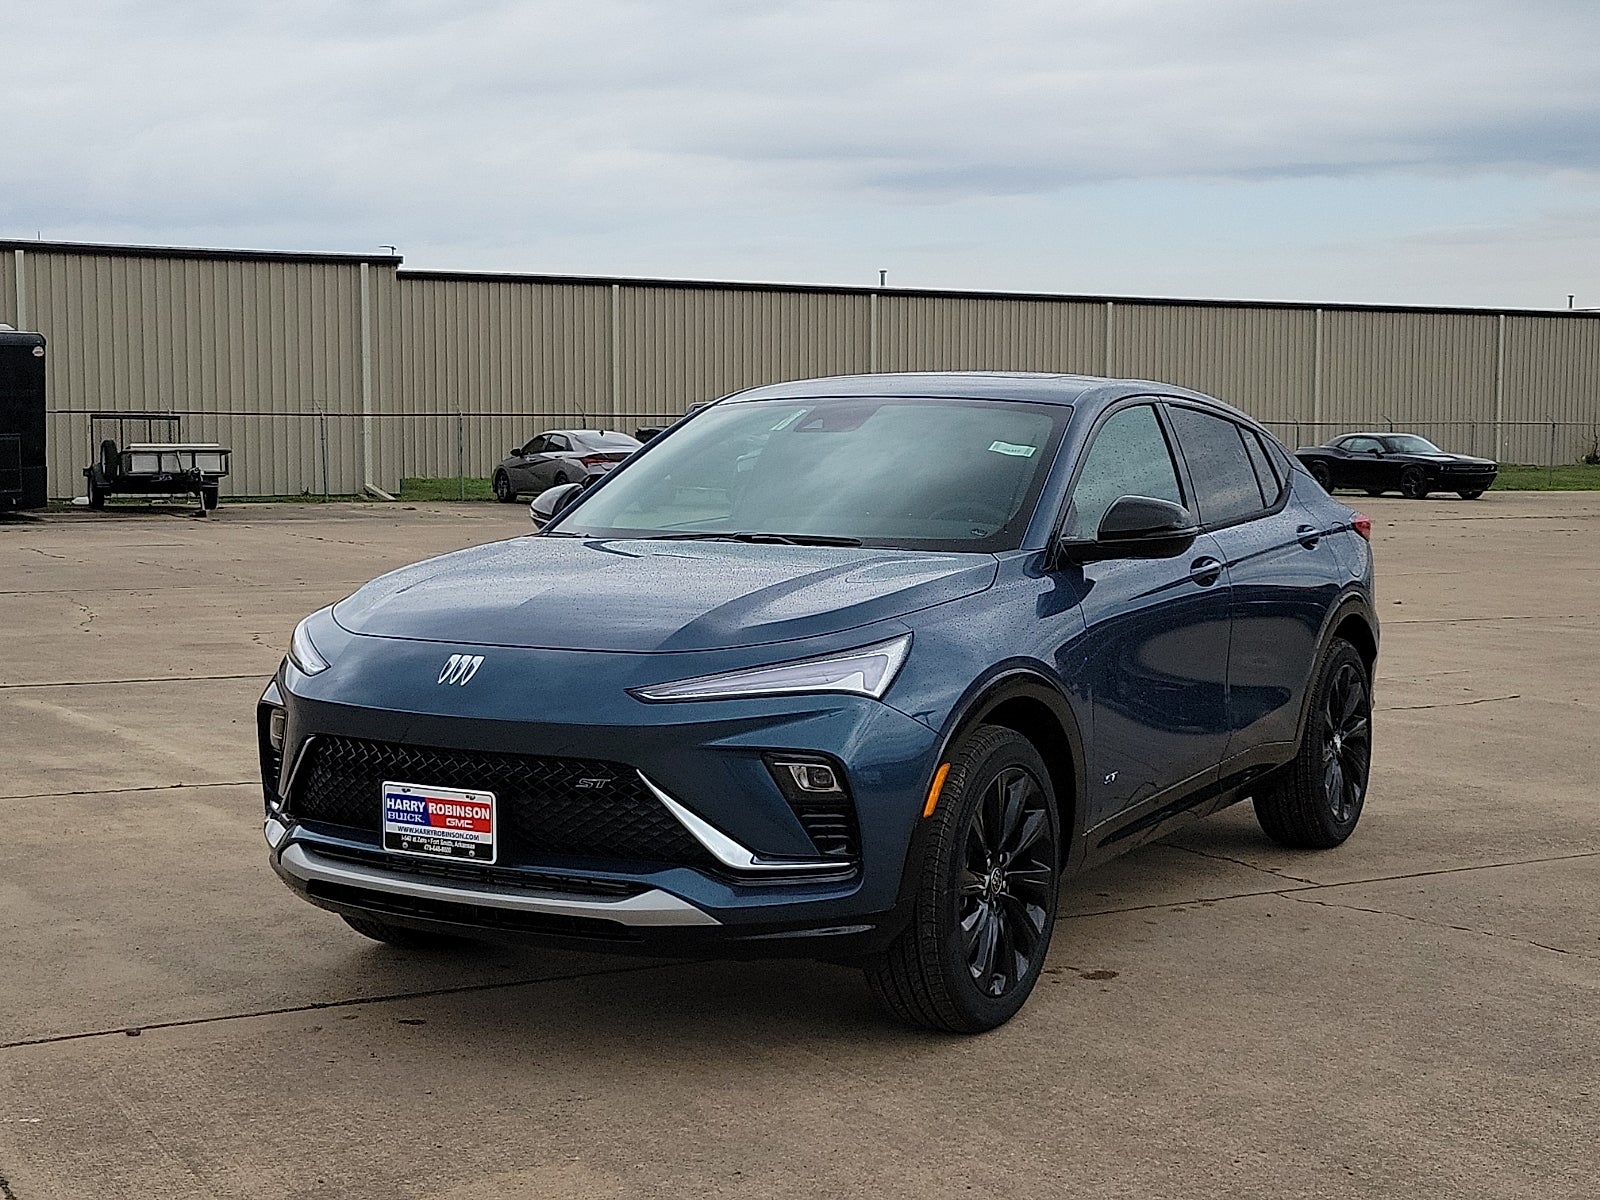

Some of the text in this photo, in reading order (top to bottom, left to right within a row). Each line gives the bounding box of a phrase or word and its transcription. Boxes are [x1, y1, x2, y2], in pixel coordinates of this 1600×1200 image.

[575, 778, 611, 789] ST
[386, 798, 490, 820] HARRY ROBINSON
[387, 811, 422, 823] BUICK
[445, 817, 474, 829] GMC
[397, 825, 480, 841] WWW.HARRYROBINSON.COM
